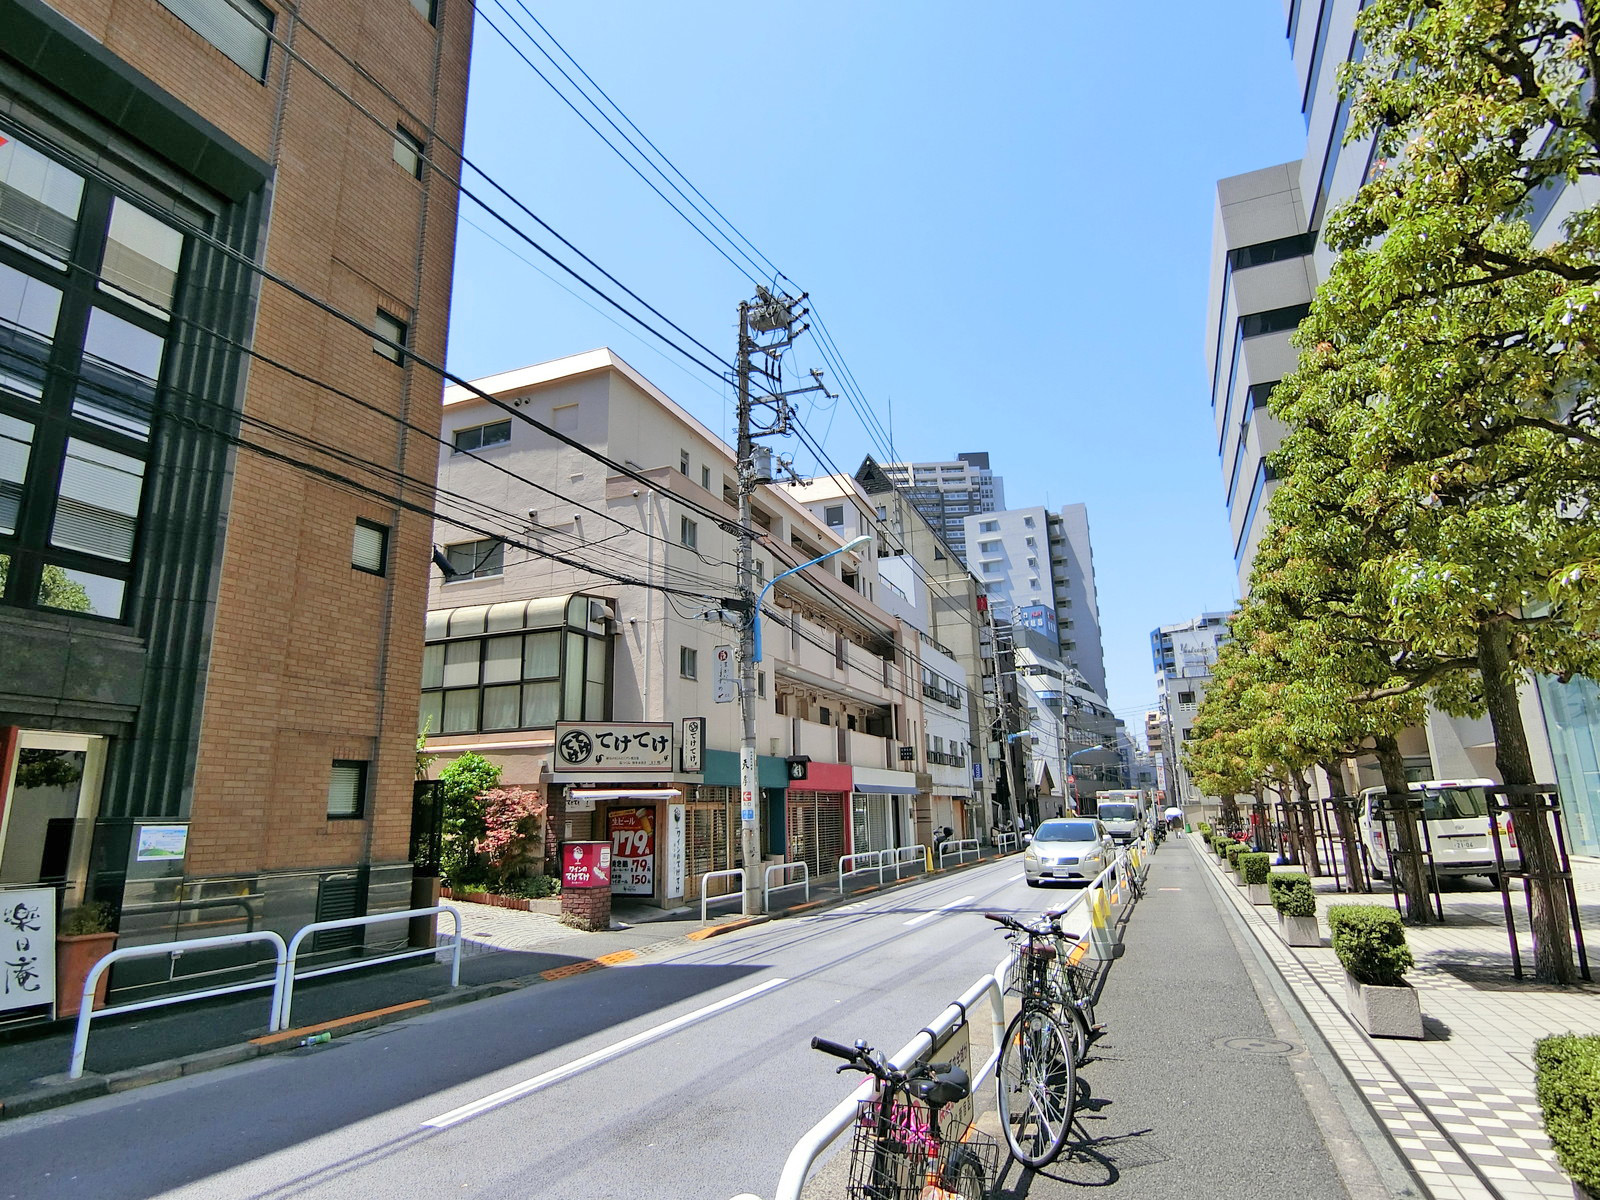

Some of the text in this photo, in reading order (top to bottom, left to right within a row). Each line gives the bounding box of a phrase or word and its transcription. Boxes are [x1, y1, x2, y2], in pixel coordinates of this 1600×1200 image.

[595, 731, 669, 754] てけてけ
[689, 732, 697, 762] てけてけ
[611, 816, 636, 826] 生ビール
[569, 865, 588, 873] ワインの
[565, 872, 591, 882] てけてけ
